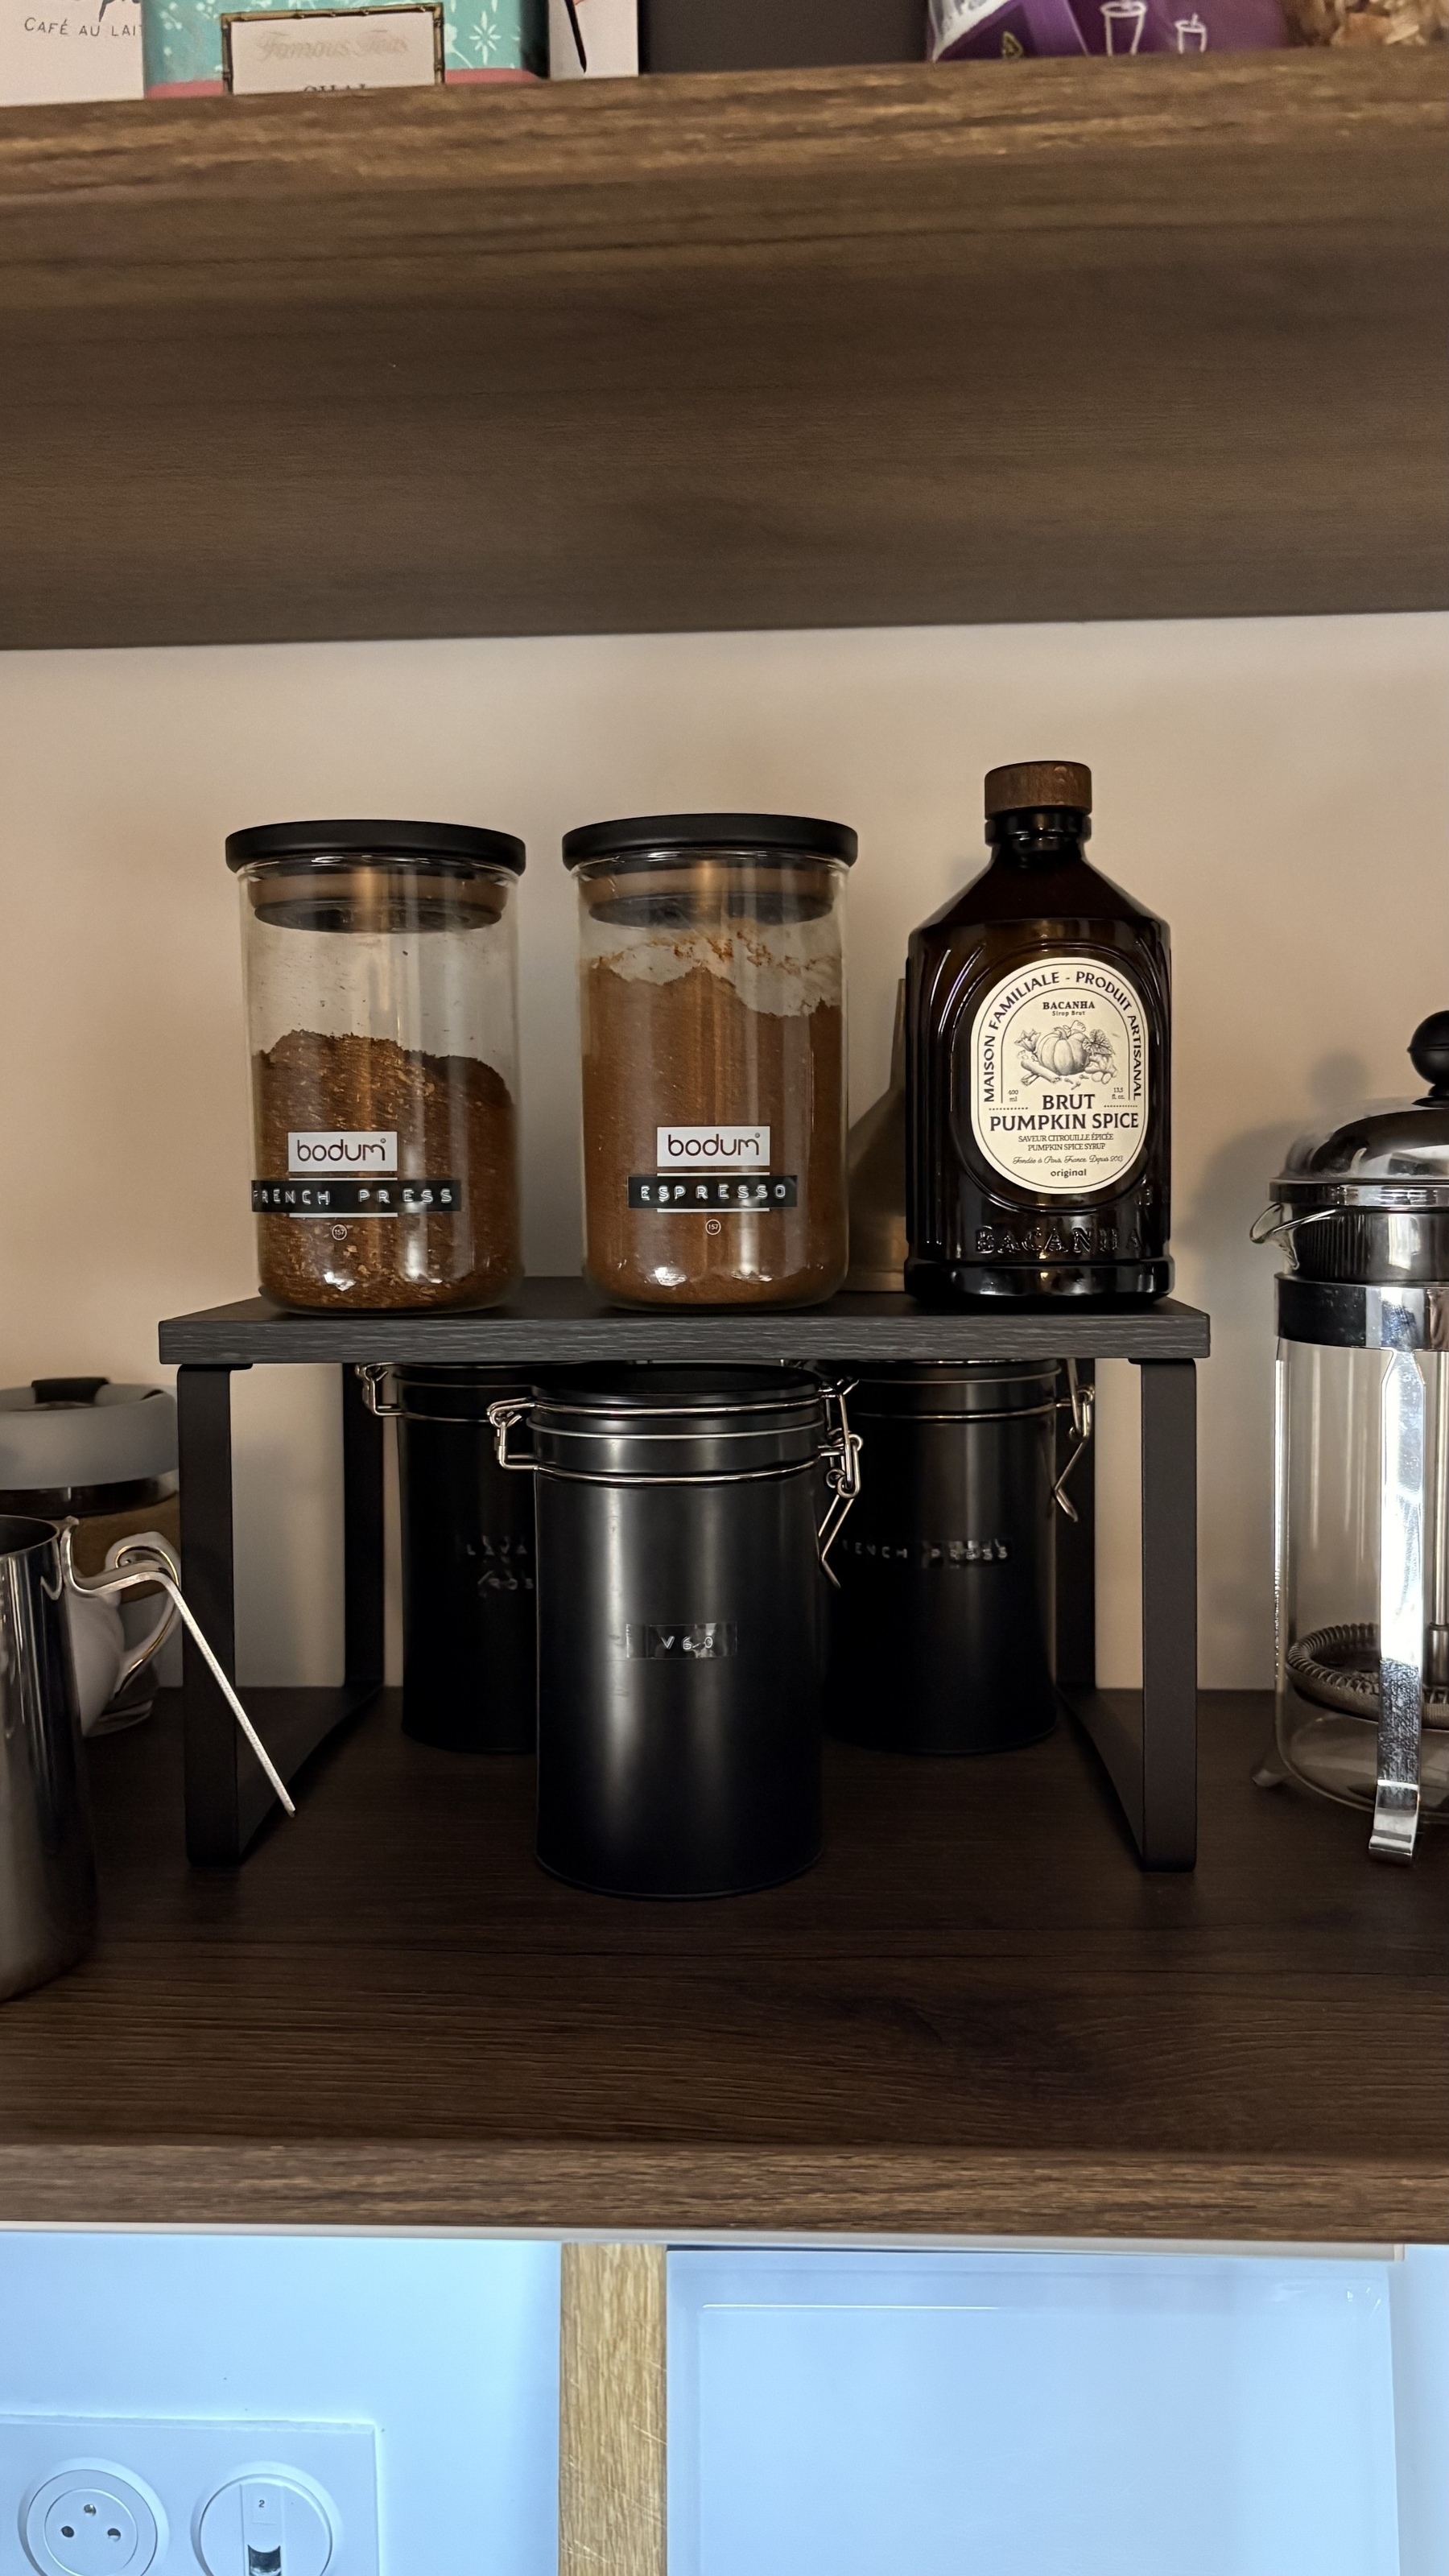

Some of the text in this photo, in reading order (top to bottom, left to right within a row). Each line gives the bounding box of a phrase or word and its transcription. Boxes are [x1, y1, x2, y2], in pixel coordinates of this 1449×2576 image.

[24, 17, 68, 35] CAFÉ
[79, 25, 100, 36] AU
[1075, 971, 1132, 1011] PRODUIT
[989, 972, 1059, 1030] FAMILIALE
[1042, 1001, 1096, 1010] BACANHA
[1127, 1015, 1141, 1101] ARTISANAL
[984, 1035, 996, 1102] MAISON
[1042, 1094, 1096, 1110] BRUT
[990, 1113, 1139, 1131] PUMPKIN SPICE
[1091, 1132, 1114, 1141] ÉPICÉE
[1051, 1169, 1087, 1179] original
[253, 1188, 452, 1206] FRENCH PRESS
[641, 1184, 786, 1201] ESPRESSO
[258, 2500, 265, 2508] 2
